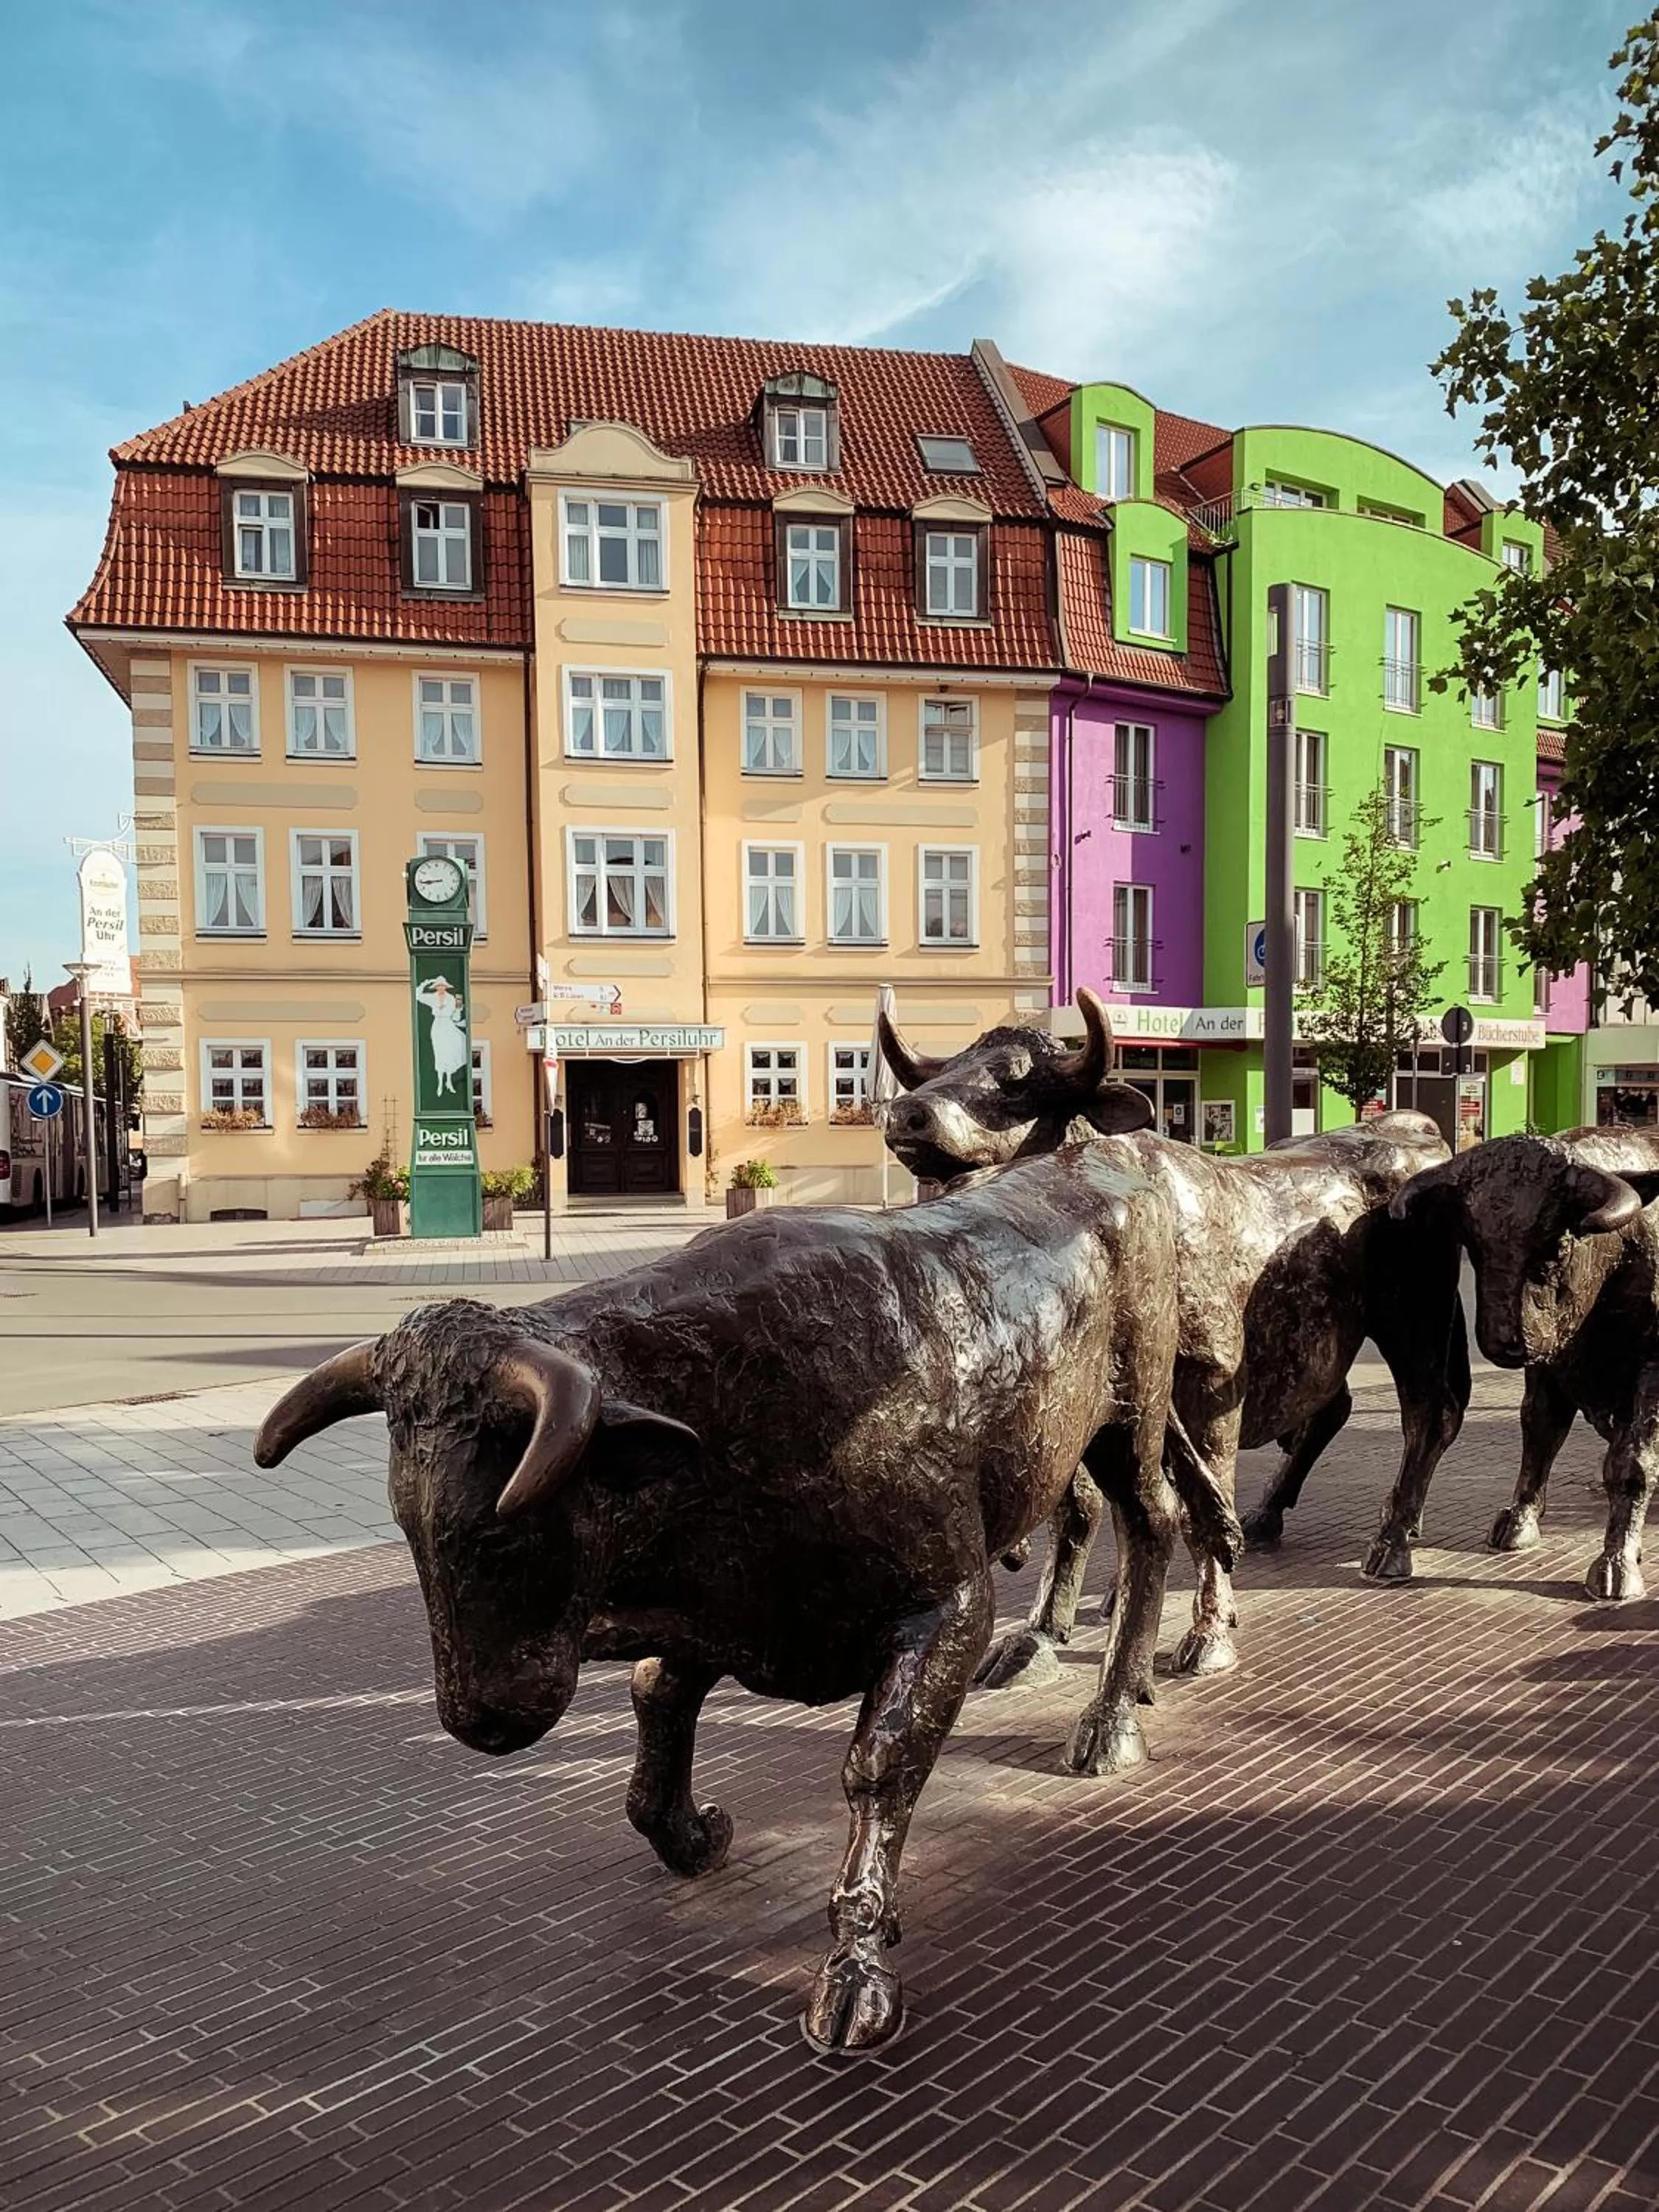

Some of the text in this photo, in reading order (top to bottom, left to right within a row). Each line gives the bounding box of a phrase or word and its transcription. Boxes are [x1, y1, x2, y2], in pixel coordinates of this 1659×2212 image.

[86, 917, 125, 931] Persil
[96, 931, 116, 941] Uhr
[412, 927, 464, 946] Persil
[1138, 1009, 1183, 1033] Hotel
[1195, 1016, 1215, 1030] An
[1220, 1015, 1244, 1030] der
[595, 1033, 613, 1046] An
[616, 1032, 636, 1046] der
[639, 1029, 717, 1046] Persiluhr
[420, 1128, 468, 1147] Persil
